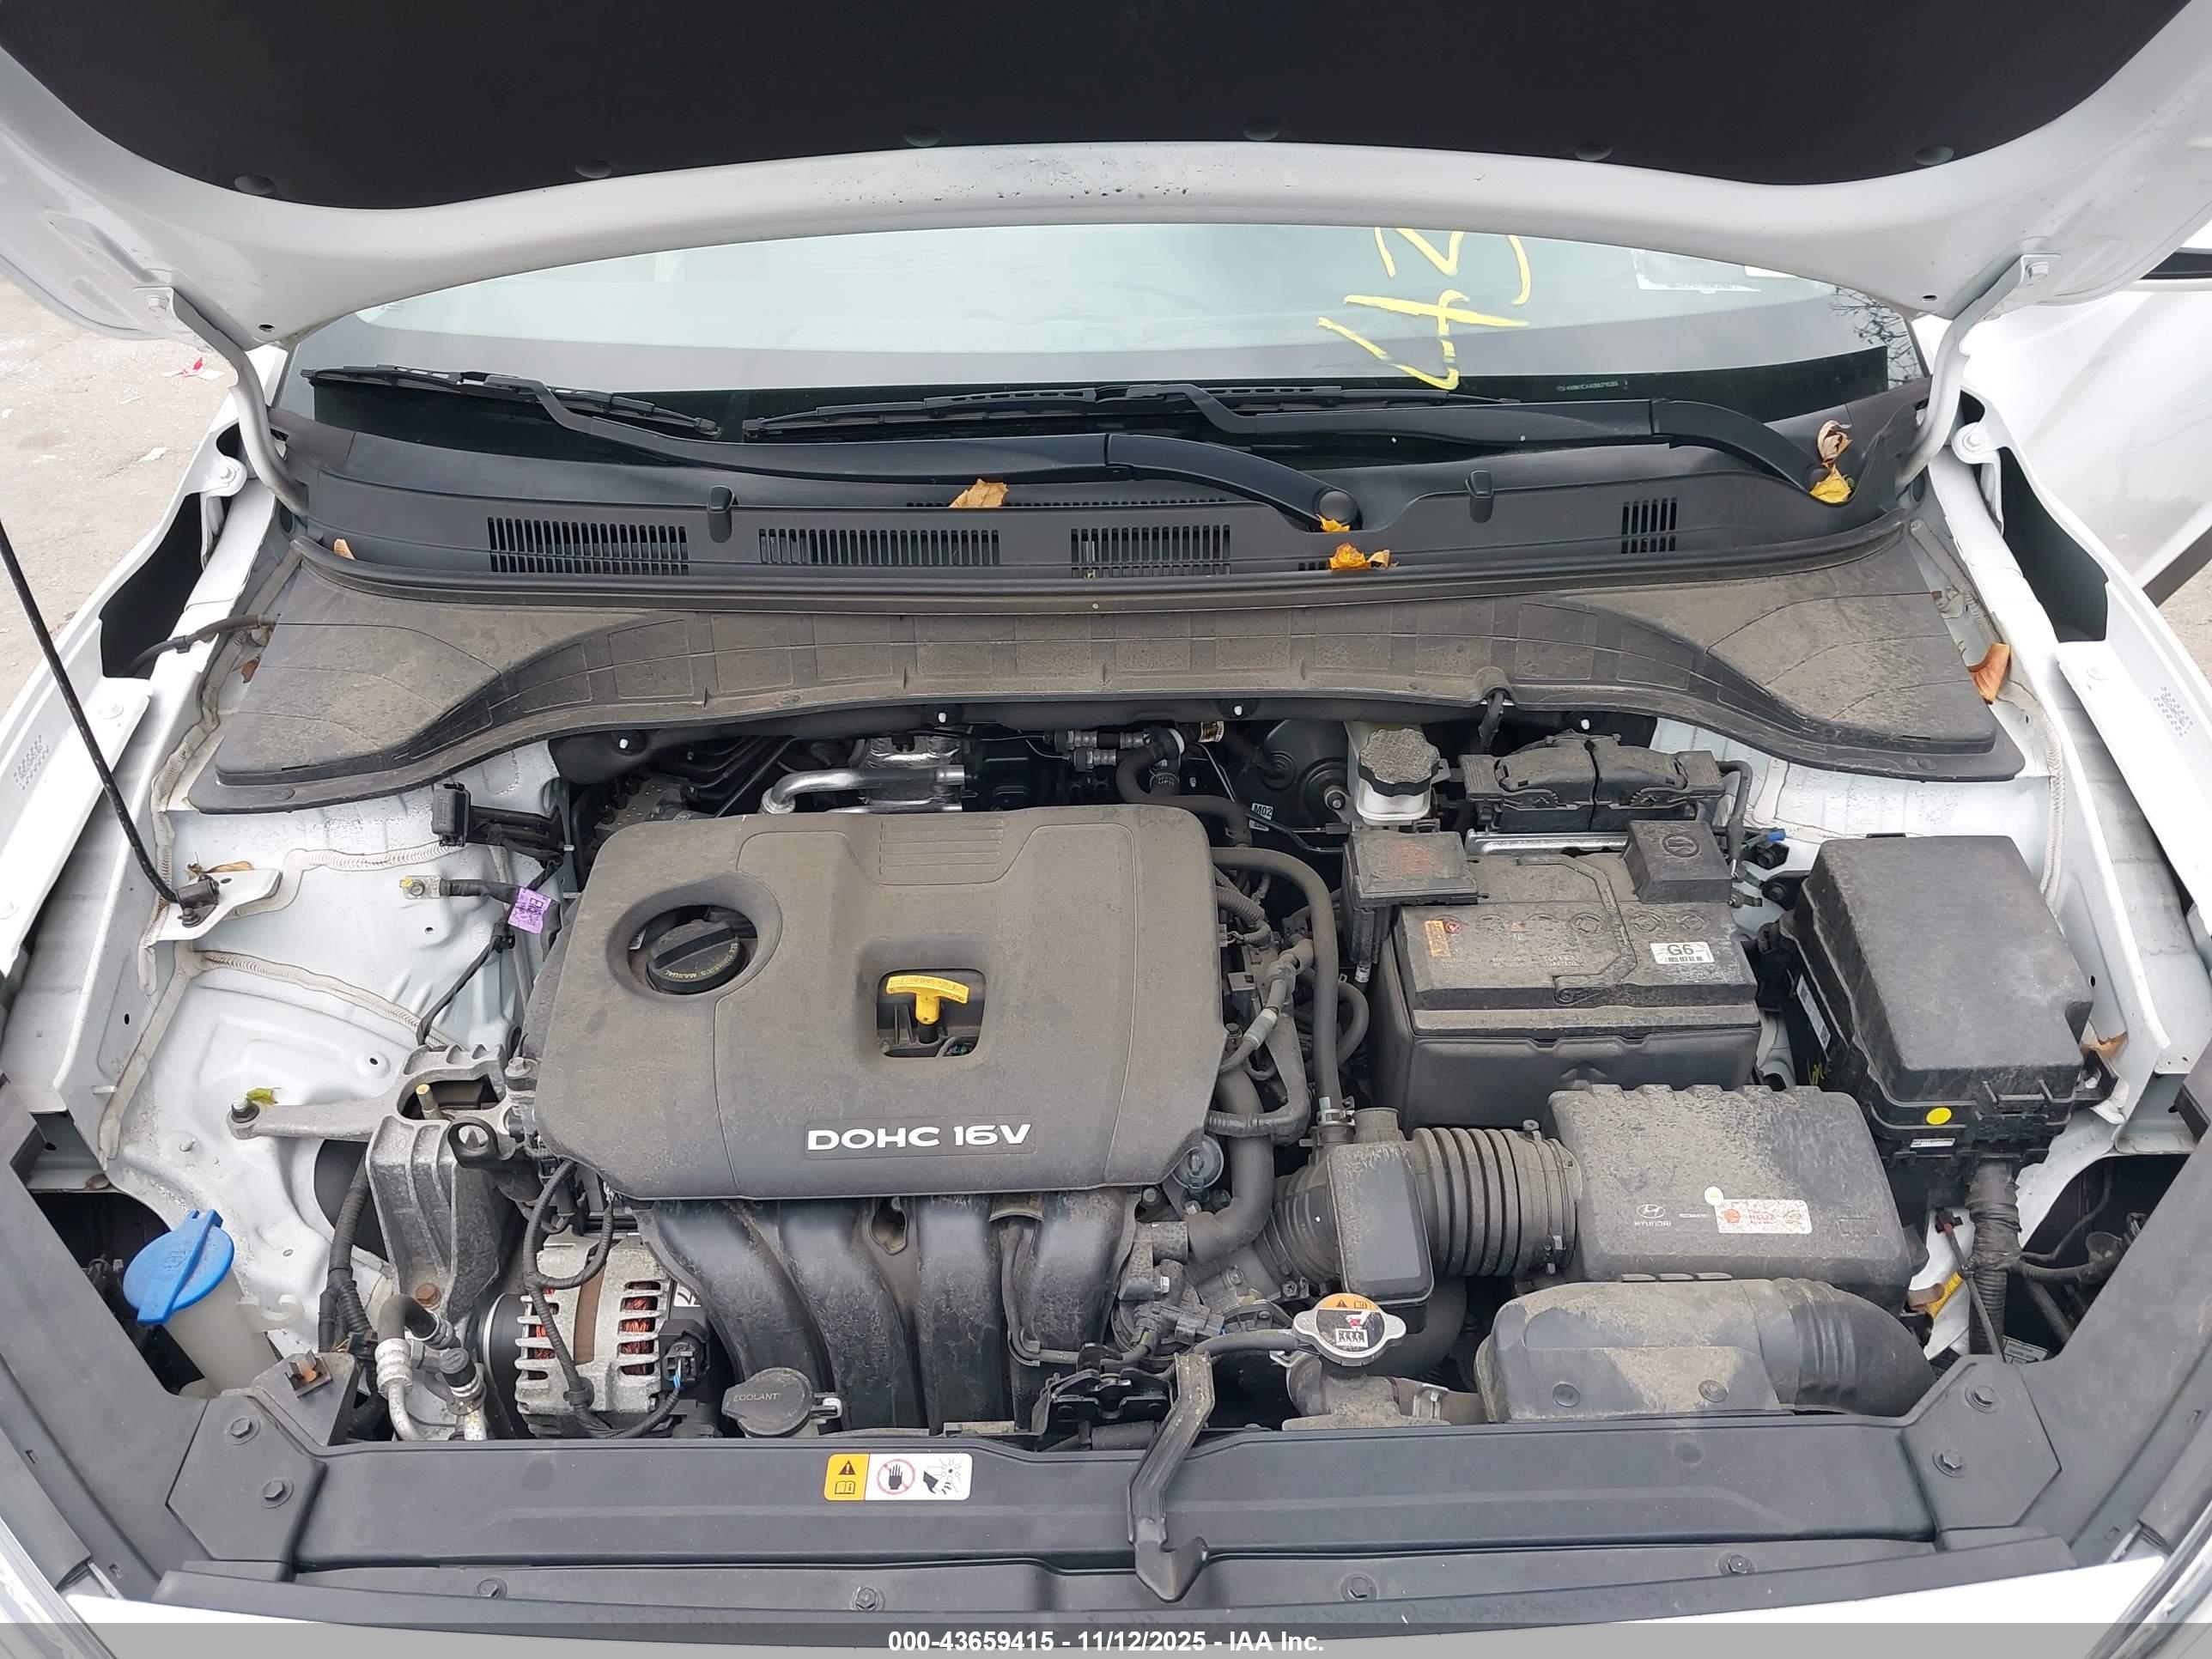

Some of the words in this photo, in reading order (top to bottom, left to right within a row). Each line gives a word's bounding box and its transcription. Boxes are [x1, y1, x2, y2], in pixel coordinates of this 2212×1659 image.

[1254, 804, 1273, 817] M02
[1667, 944, 1694, 956] G6
[664, 969, 698, 980] MANUAL
[807, 1127, 941, 1151] DOHC
[954, 1123, 1031, 1146] 16V
[733, 1392, 781, 1402] COOLANT
